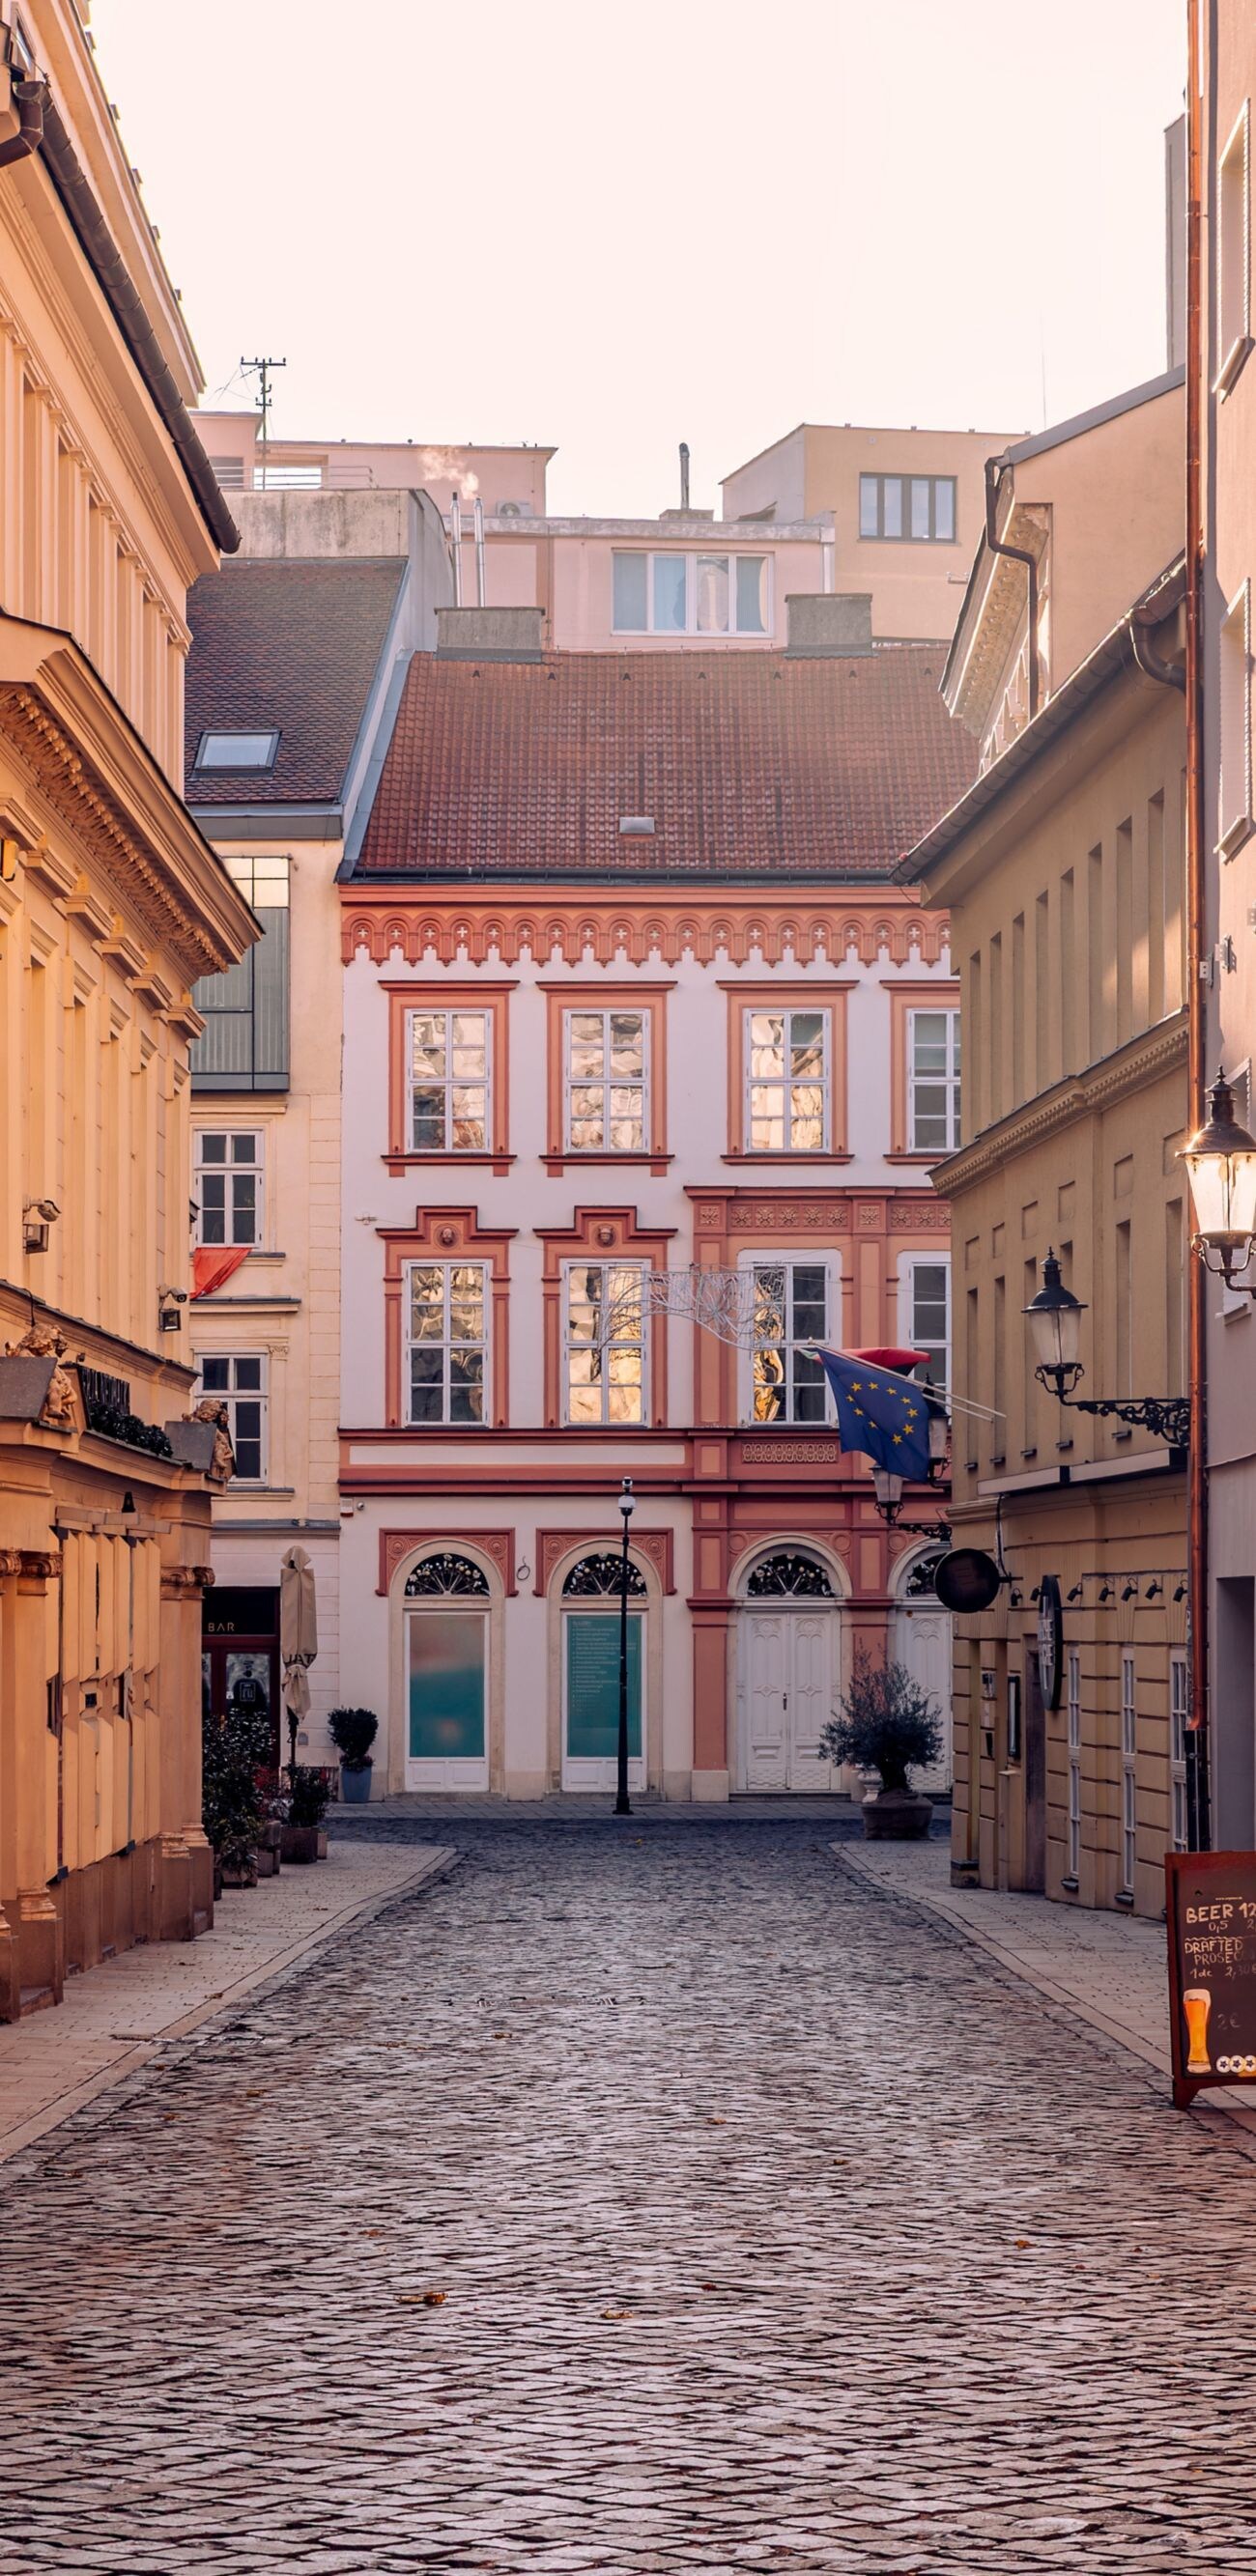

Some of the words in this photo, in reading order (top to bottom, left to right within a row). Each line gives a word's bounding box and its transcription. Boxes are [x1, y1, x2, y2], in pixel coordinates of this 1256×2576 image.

[208, 1622, 235, 1632] BAR
[1186, 1904, 1233, 1923] BEER
[1209, 1920, 1229, 1933] 0,5
[1185, 1939, 1243, 1954] DRAFTED
